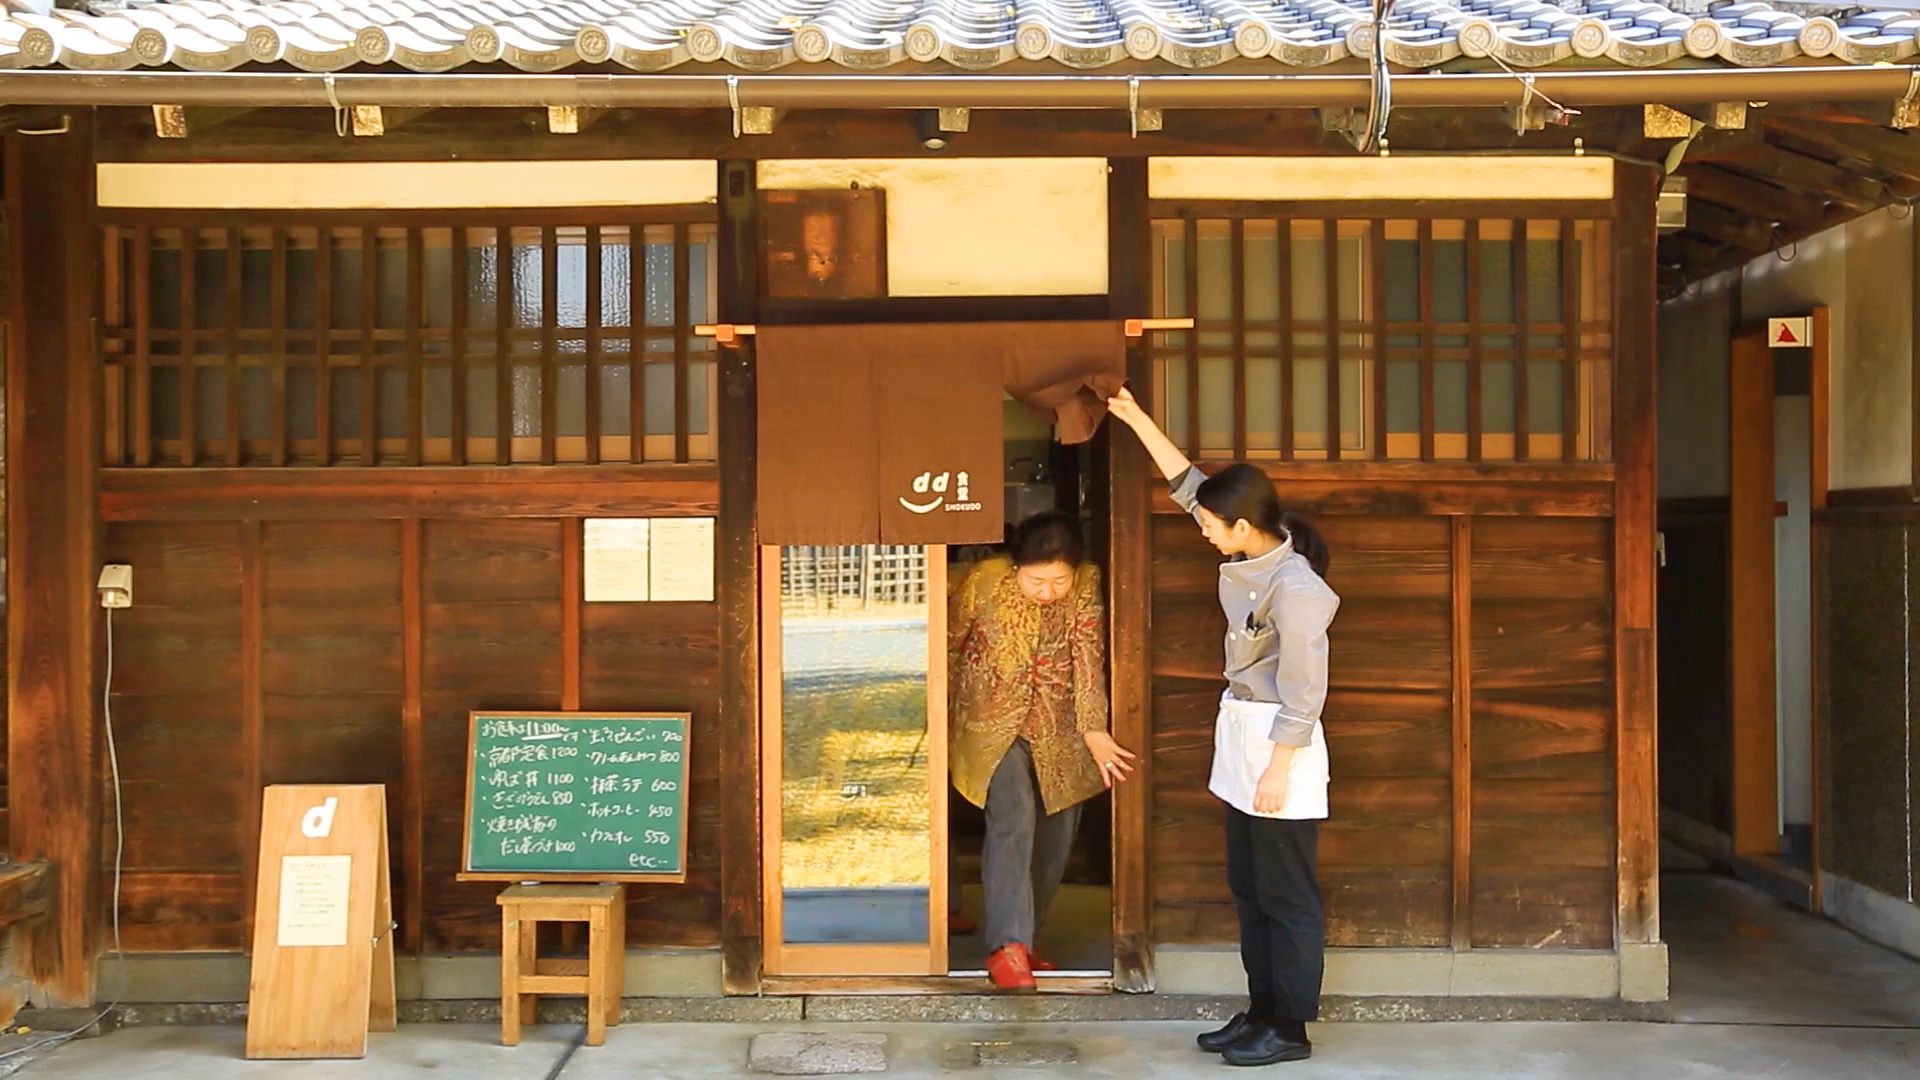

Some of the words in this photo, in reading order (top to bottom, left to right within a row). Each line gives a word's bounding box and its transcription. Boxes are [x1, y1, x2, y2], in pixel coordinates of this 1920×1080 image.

[913, 472, 950, 493] dd
[957, 471, 969, 501] 食堂
[945, 503, 982, 512] SHOKUDO
[489, 745, 549, 768] 京都定食
[552, 747, 578, 759] 1200
[659, 750, 680, 762] 800
[548, 773, 574, 785] 1100
[591, 774, 642, 795] 抹茶ラテ
[651, 778, 677, 792] 600
[302, 797, 339, 838] d
[588, 802, 640, 818] ホットコーヒー
[648, 804, 673, 817] 450
[591, 828, 633, 845] カフェオレ
[644, 830, 670, 844] 550
[556, 840, 576, 852] 1000
